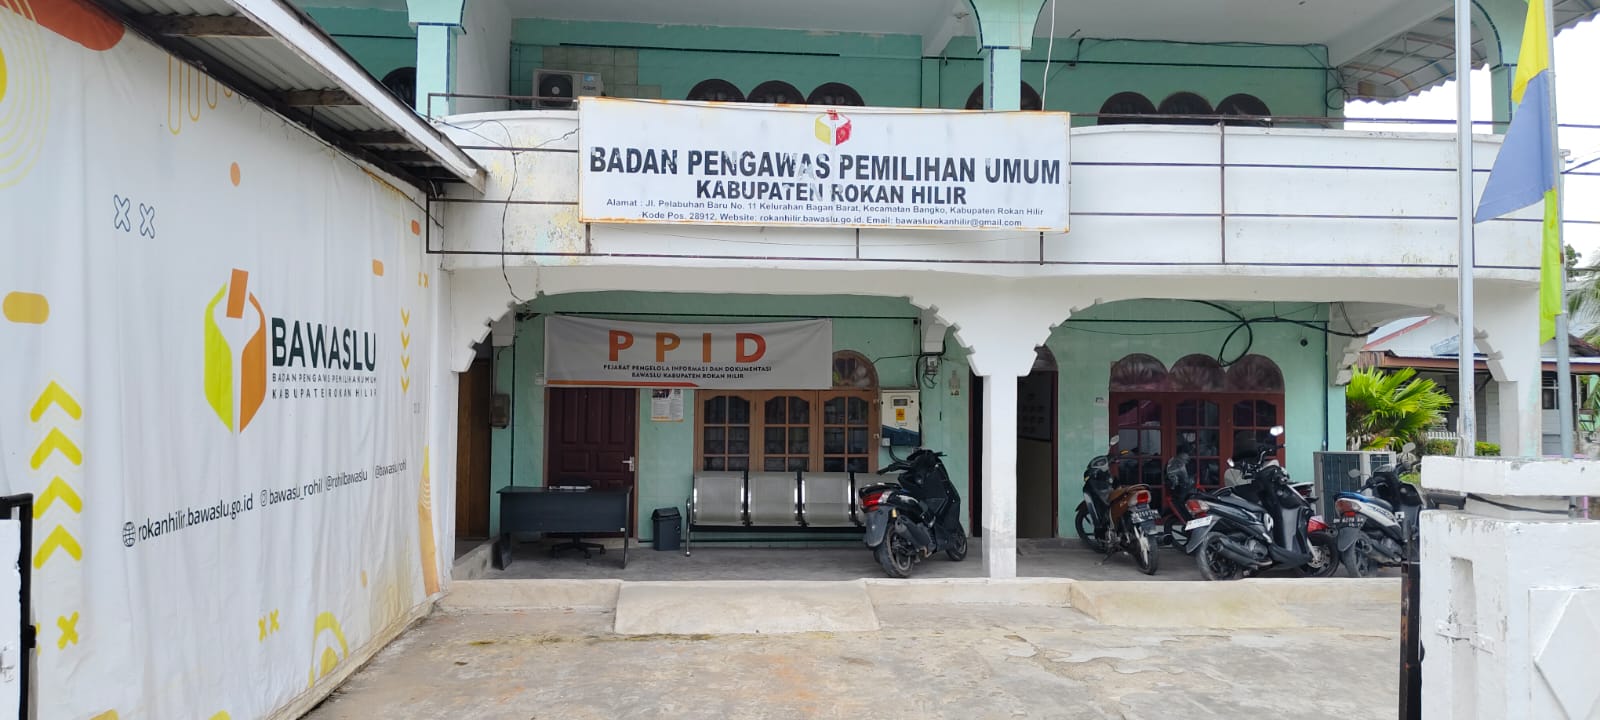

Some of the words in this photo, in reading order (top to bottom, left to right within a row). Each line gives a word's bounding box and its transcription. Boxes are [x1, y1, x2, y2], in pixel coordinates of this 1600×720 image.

[590, 146, 678, 175] BADAN
[687, 149, 831, 180] PENGAWAS
[839, 154, 976, 183] PEMILIHAN
[984, 157, 1060, 185] UMUM
[696, 179, 824, 202] KABUPATEN
[830, 183, 905, 204] ROKAN
[911, 185, 967, 205] HILIR
[606, 198, 637, 208] Alamat
[645, 200, 656, 208] Jl.
[658, 200, 705, 209] Pelabuhan
[707, 201, 728, 209] Baru
[730, 201, 744, 210] No.
[748, 202, 757, 210] 11
[759, 202, 804, 211] Kelurahan
[806, 203, 834, 213] Bagan
[863, 204, 911, 213] Kecamatan
[912, 205, 948, 215] Bangko,
[950, 207, 996, 217] Kabupaten
[997, 207, 1025, 215] Rokan
[1026, 208, 1044, 216] Hilir
[641, 211, 665, 219] Kode
[667, 211, 685, 220] Pos.
[719, 213, 758, 222] Website:
[865, 215, 892, 224] Email:
[895, 216, 1022, 227] bawaslurokanhilir@gmail.com
[271, 317, 376, 372] BAWASLU
[272, 372, 297, 383] BADAN
[138, 492, 253, 542] rokanhilir.bawaslu.go.id
